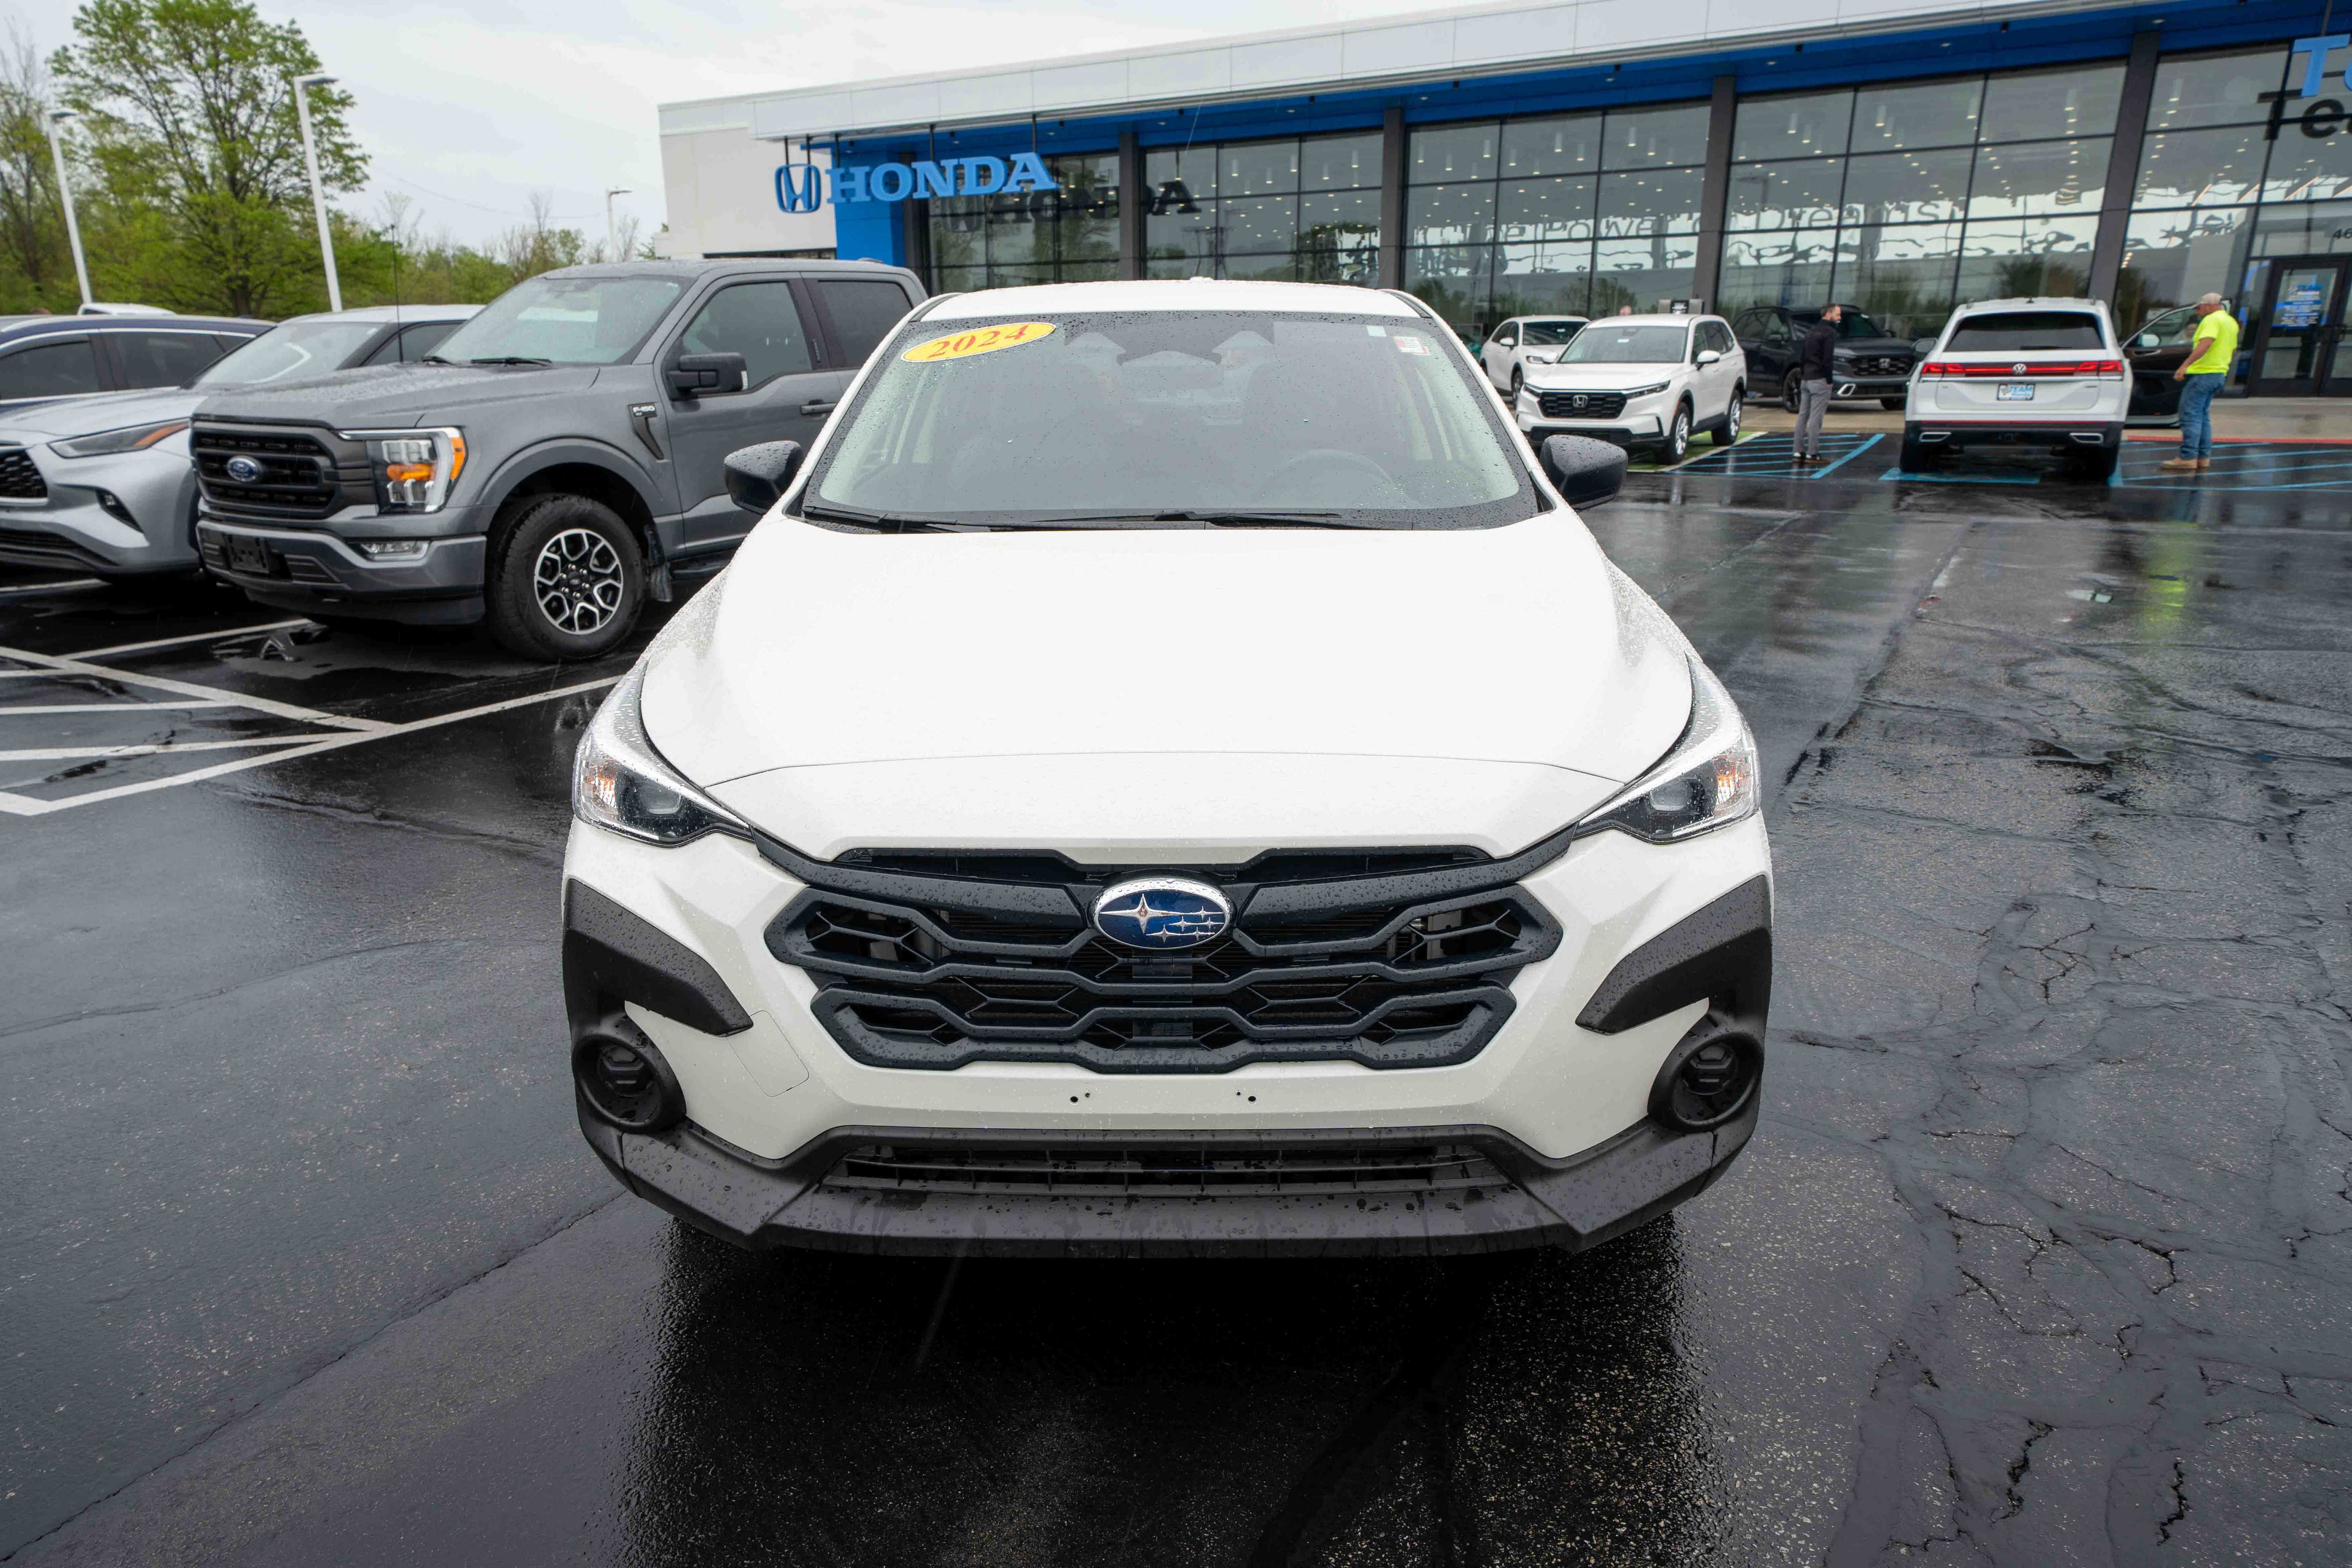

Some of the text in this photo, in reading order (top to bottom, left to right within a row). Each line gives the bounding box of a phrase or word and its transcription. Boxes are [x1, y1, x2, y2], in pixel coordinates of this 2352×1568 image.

[2292, 34, 2352, 99] T
[825, 152, 1060, 203] HONDA
[927, 325, 1028, 358] 2024
